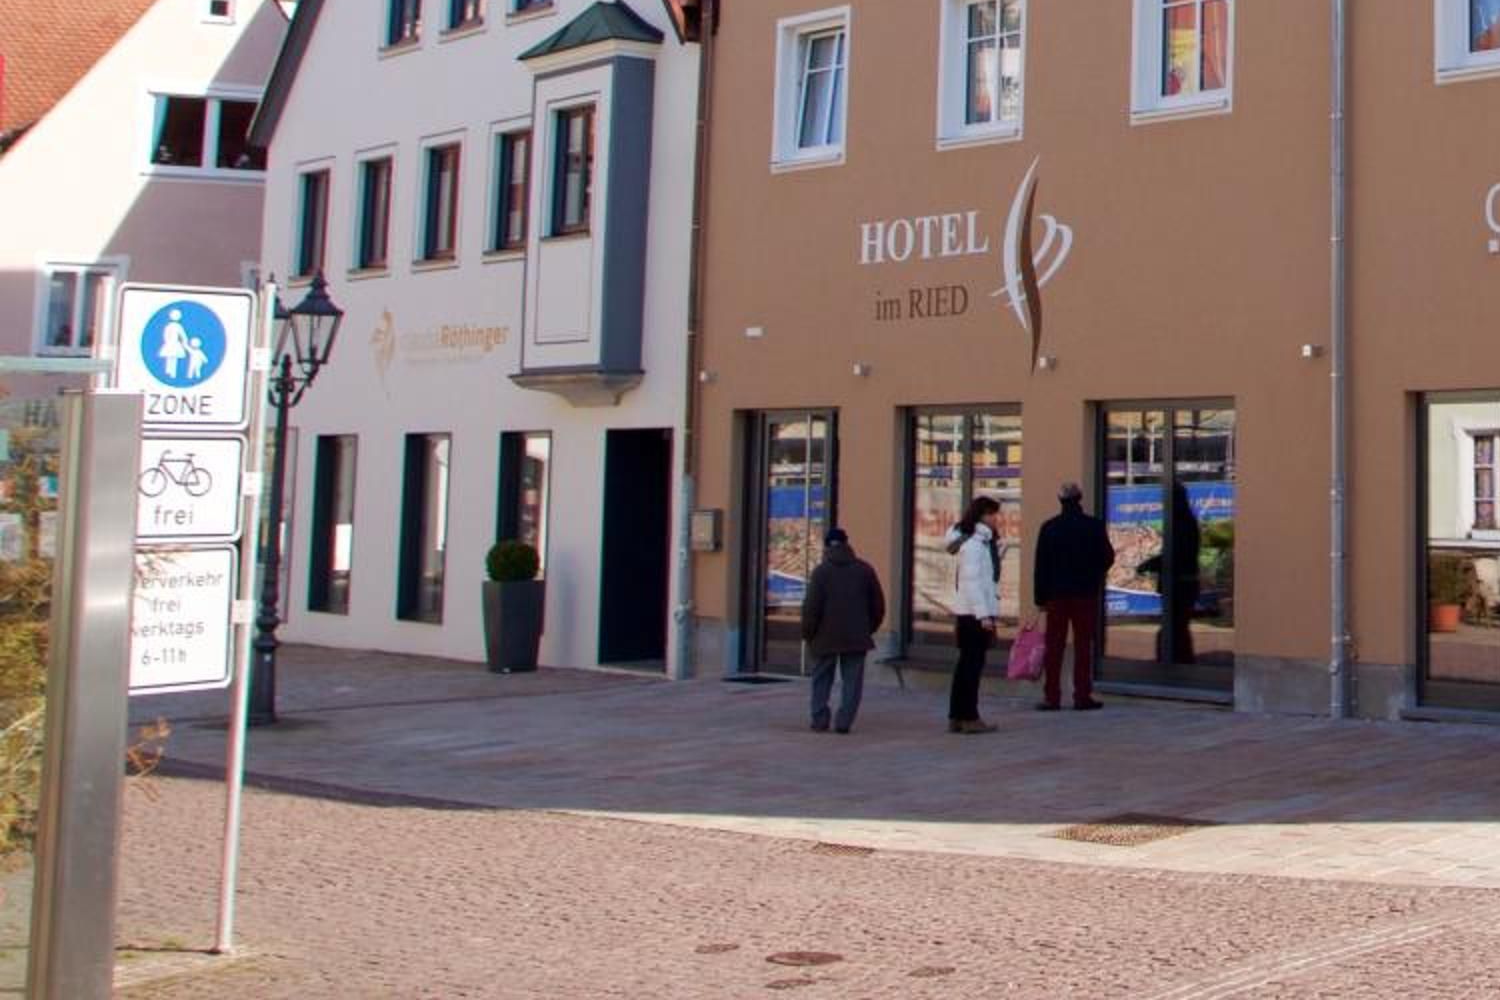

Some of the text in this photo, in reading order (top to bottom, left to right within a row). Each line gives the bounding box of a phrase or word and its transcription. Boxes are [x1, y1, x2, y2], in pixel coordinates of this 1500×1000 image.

[859, 210, 989, 264] HOTEL
[875, 284, 969, 321] im RIED
[147, 394, 213, 416] ZONE
[154, 505, 193, 526] frei
[151, 597, 182, 613] frei
